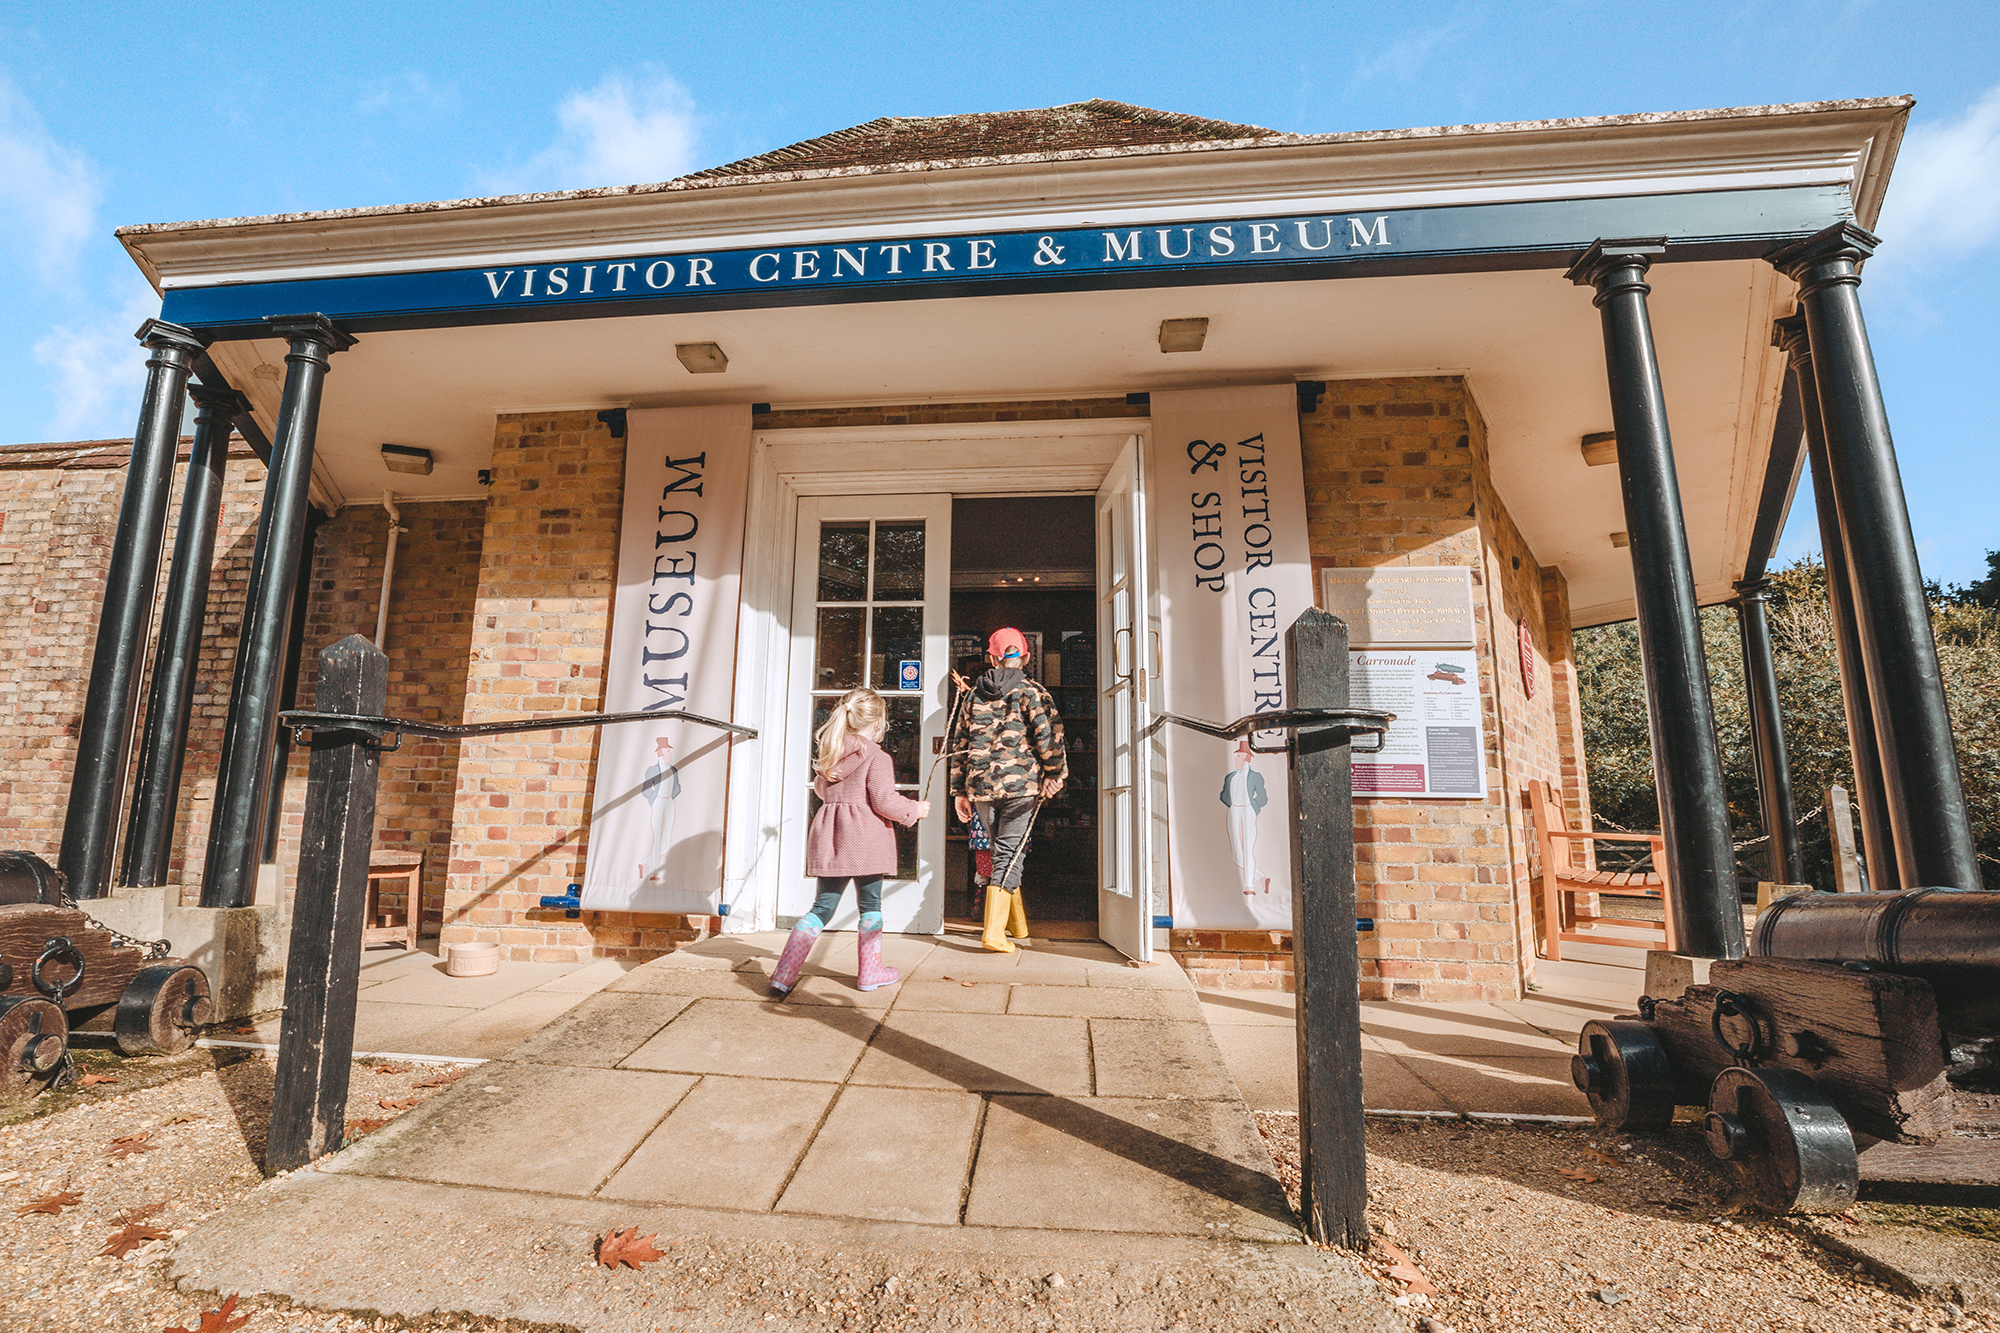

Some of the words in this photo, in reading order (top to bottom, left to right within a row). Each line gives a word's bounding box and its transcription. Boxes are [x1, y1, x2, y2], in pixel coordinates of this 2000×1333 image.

[483, 258, 716, 298] VISITOR
[749, 239, 998, 282] CENTRE
[1033, 236, 1066, 265] &
[1102, 216, 1392, 262] MUSEUM
[1186, 438, 1226, 475] &
[1237, 432, 1273, 576] VISITOR
[1191, 491, 1227, 594] SHOP
[641, 451, 706, 722] MUSEUM
[1382, 587, 1403, 596] opened
[1405, 587, 1412, 596] by
[1357, 655, 1416, 666] Carronade
[1392, 627, 1408, 636] April
